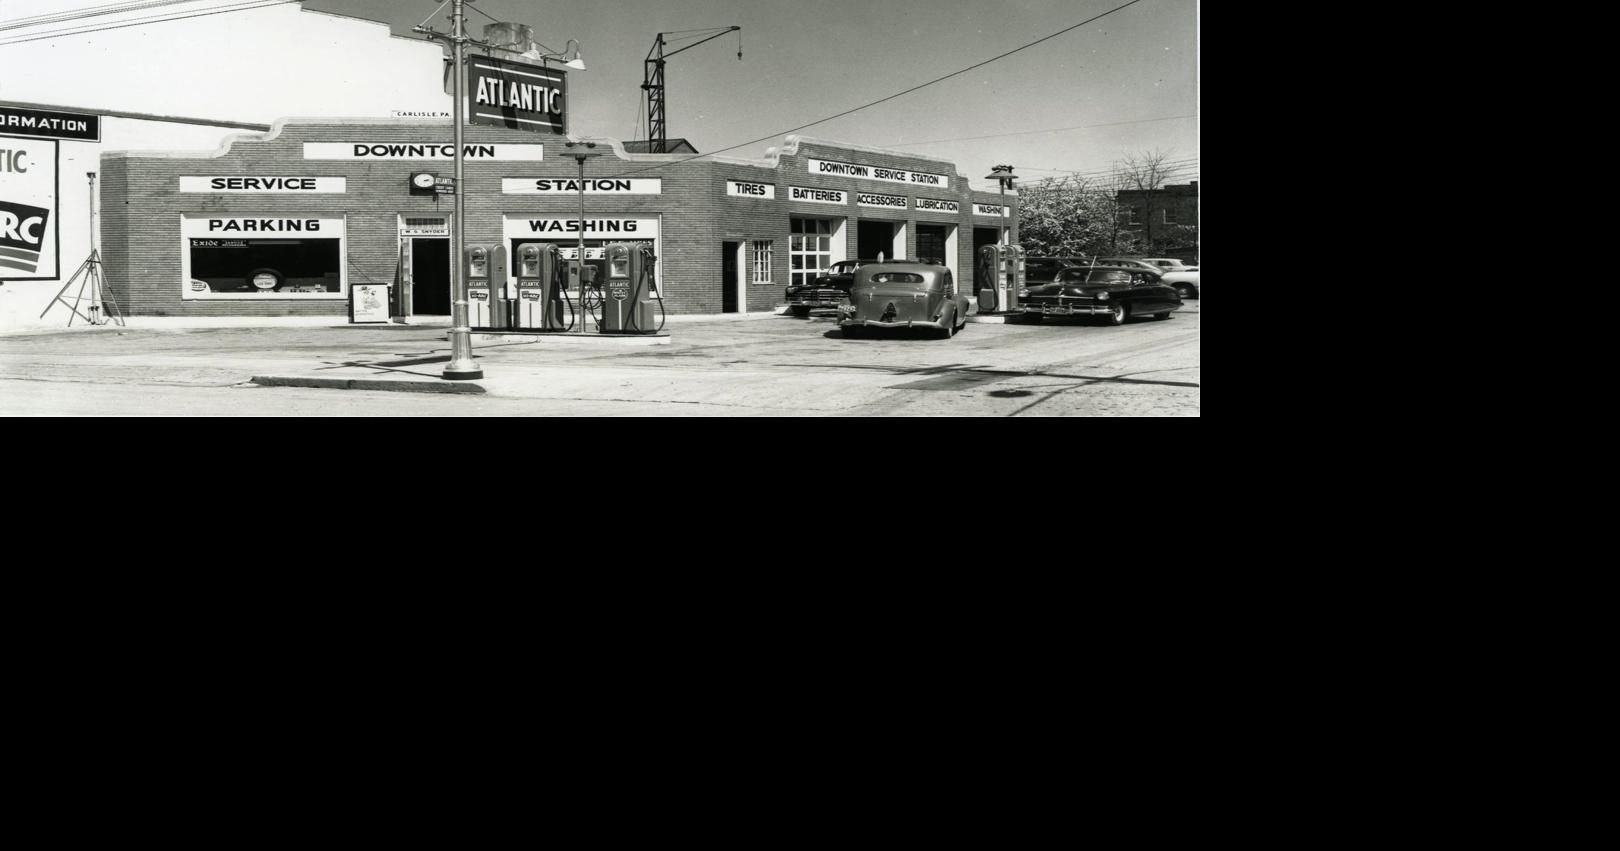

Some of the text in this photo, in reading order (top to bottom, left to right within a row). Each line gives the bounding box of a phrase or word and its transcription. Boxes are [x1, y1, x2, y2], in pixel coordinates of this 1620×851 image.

[476, 76, 561, 114] ATLANTIC
[354, 144, 495, 158] DOWNTOWN
[820, 161, 939, 185] DOWNTOWN SERVICE STATION
[211, 177, 317, 190] SERVICE
[535, 179, 631, 191] STATION
[735, 182, 766, 196] TIRES
[792, 188, 842, 202] BATTERIES
[856, 195, 906, 207] ACCESSORIES
[915, 199, 958, 211] LUBRICATION
[978, 205, 1002, 215] WASHIN
[209, 219, 320, 232] PARKING
[529, 220, 638, 232] WASHING
